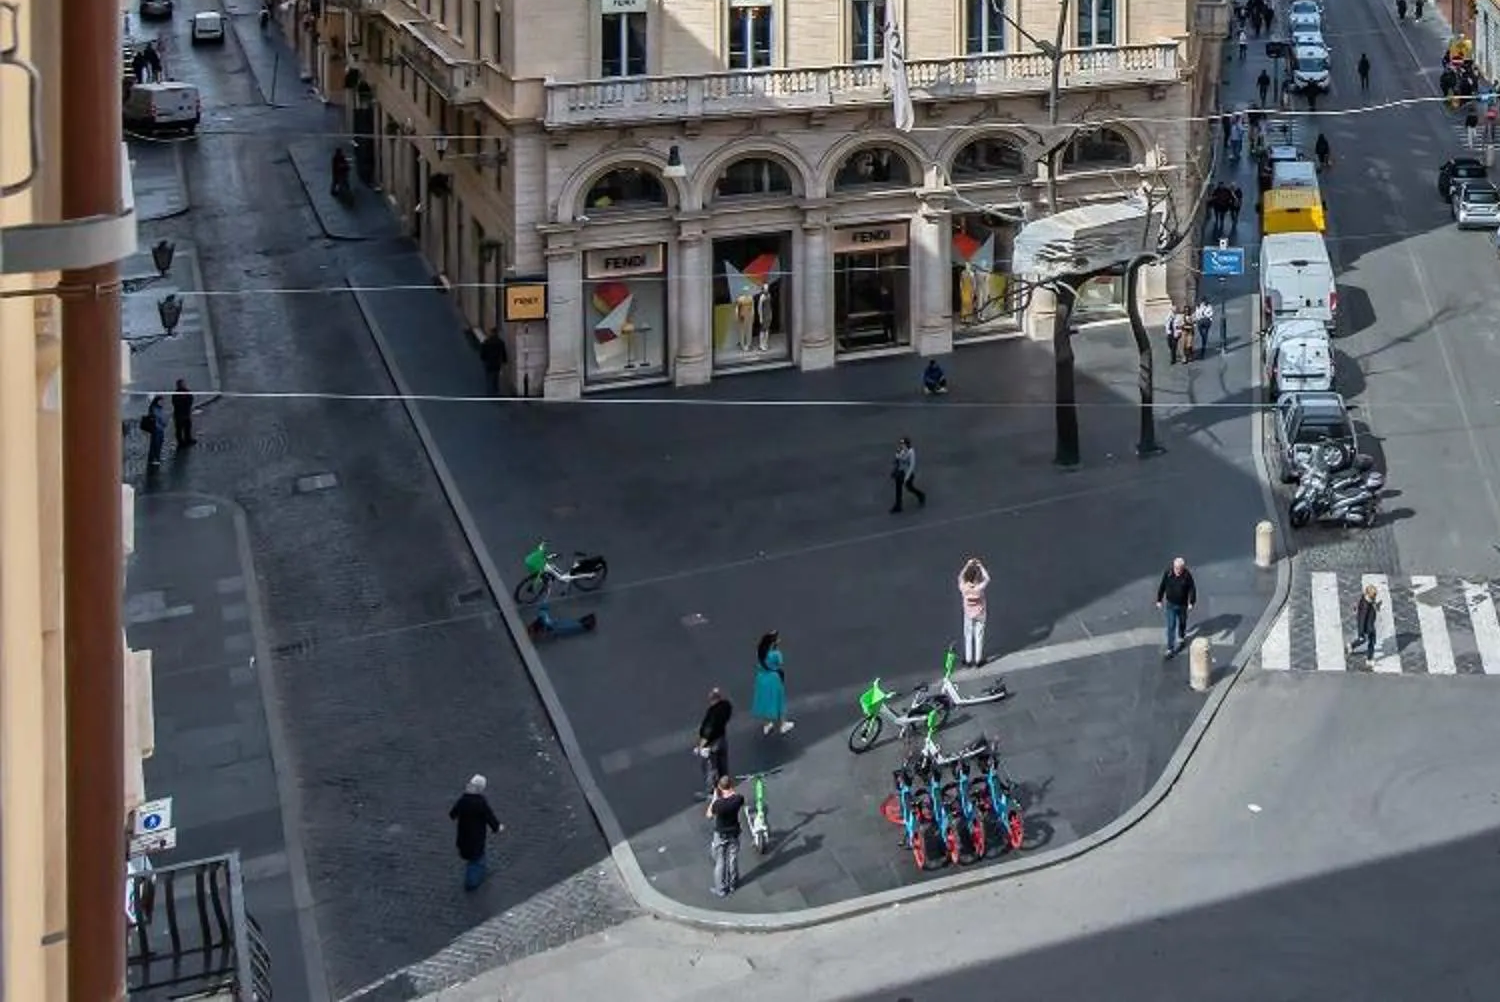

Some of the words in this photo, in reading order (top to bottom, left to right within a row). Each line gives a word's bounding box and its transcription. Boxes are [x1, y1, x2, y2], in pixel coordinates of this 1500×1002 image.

[852, 229, 891, 243] FENDI
[605, 255, 646, 270] FENDI
[513, 296, 539, 306] FENDI
